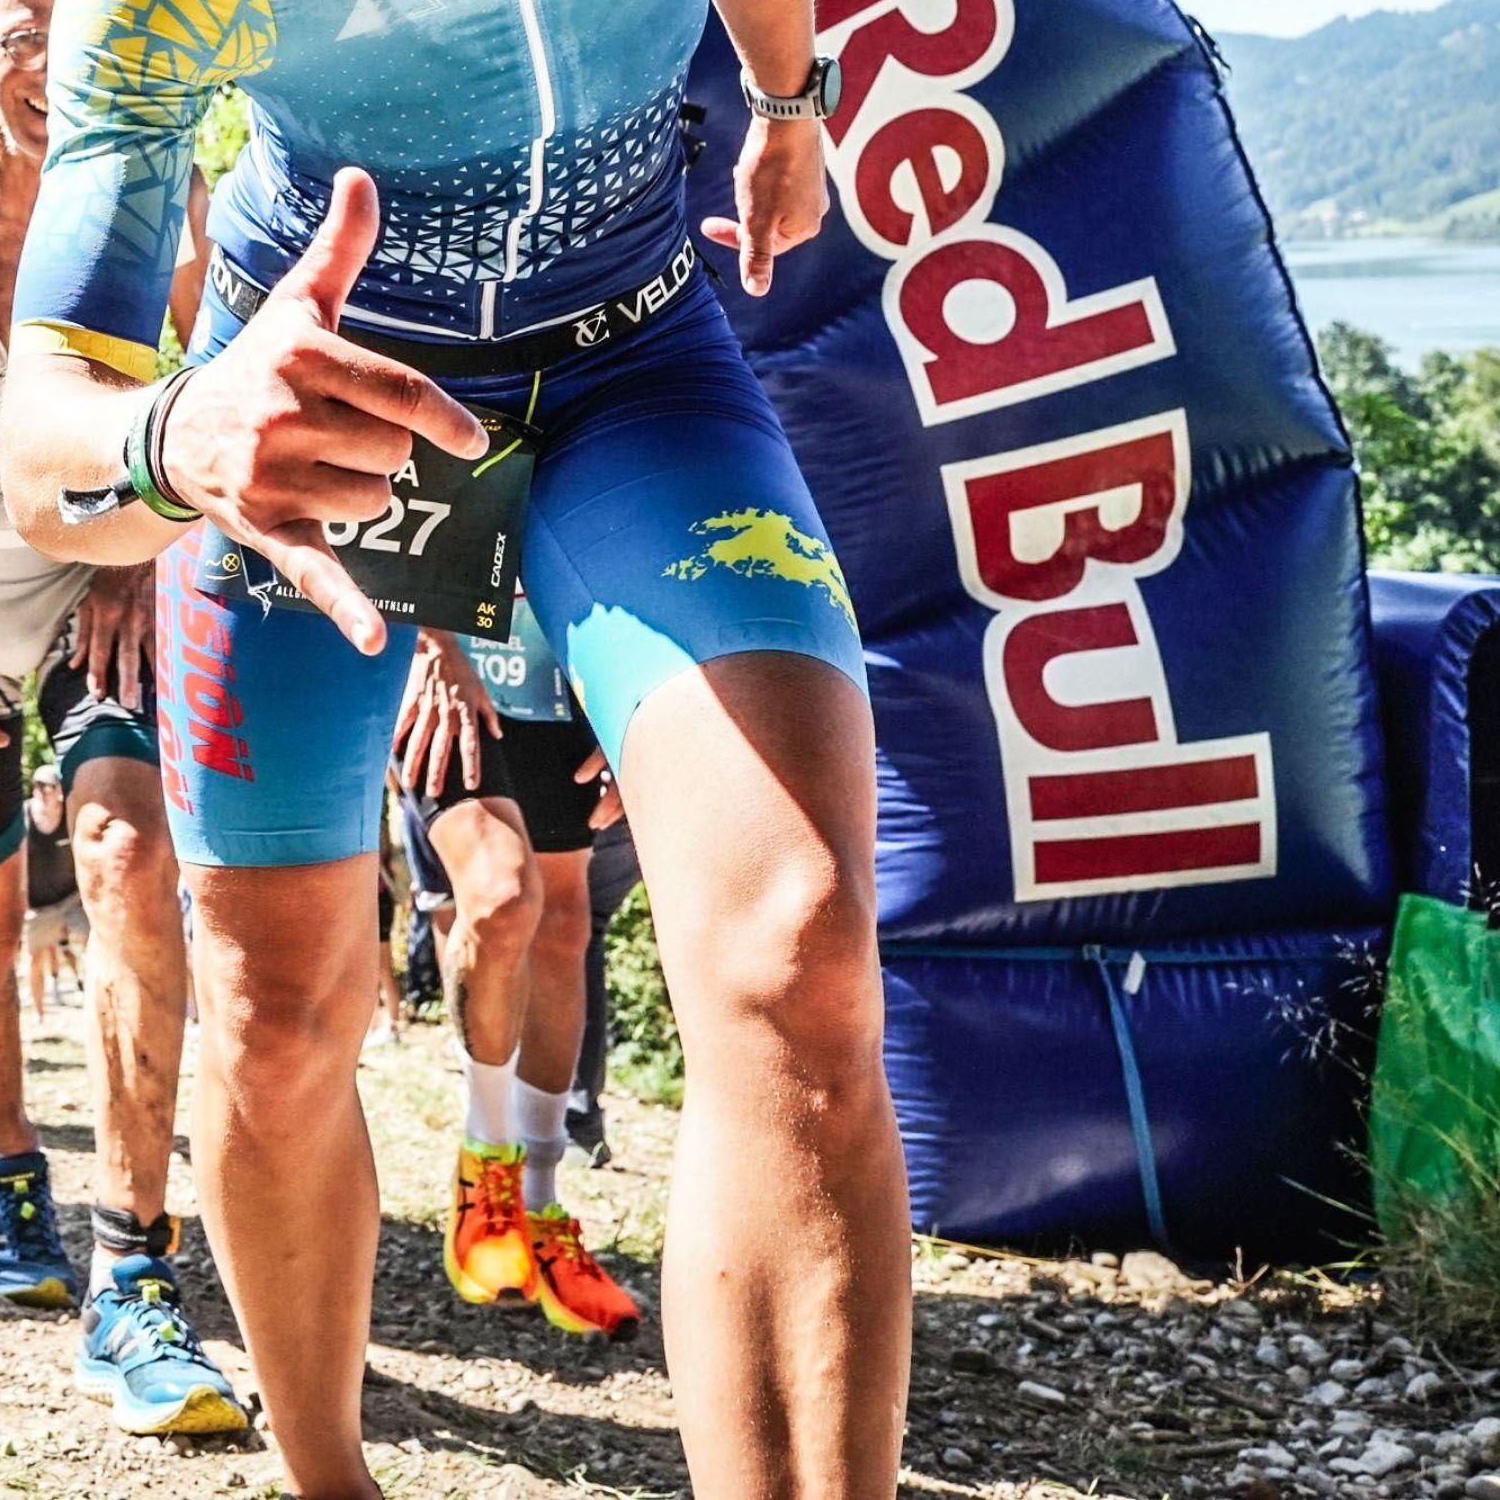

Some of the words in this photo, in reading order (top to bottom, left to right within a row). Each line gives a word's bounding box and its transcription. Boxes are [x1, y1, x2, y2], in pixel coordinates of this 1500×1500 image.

[491, 532, 507, 588] CADEX
[477, 602, 496, 616] AK
[477, 616, 493, 629] 30
[941, 409, 1276, 901] Bull
